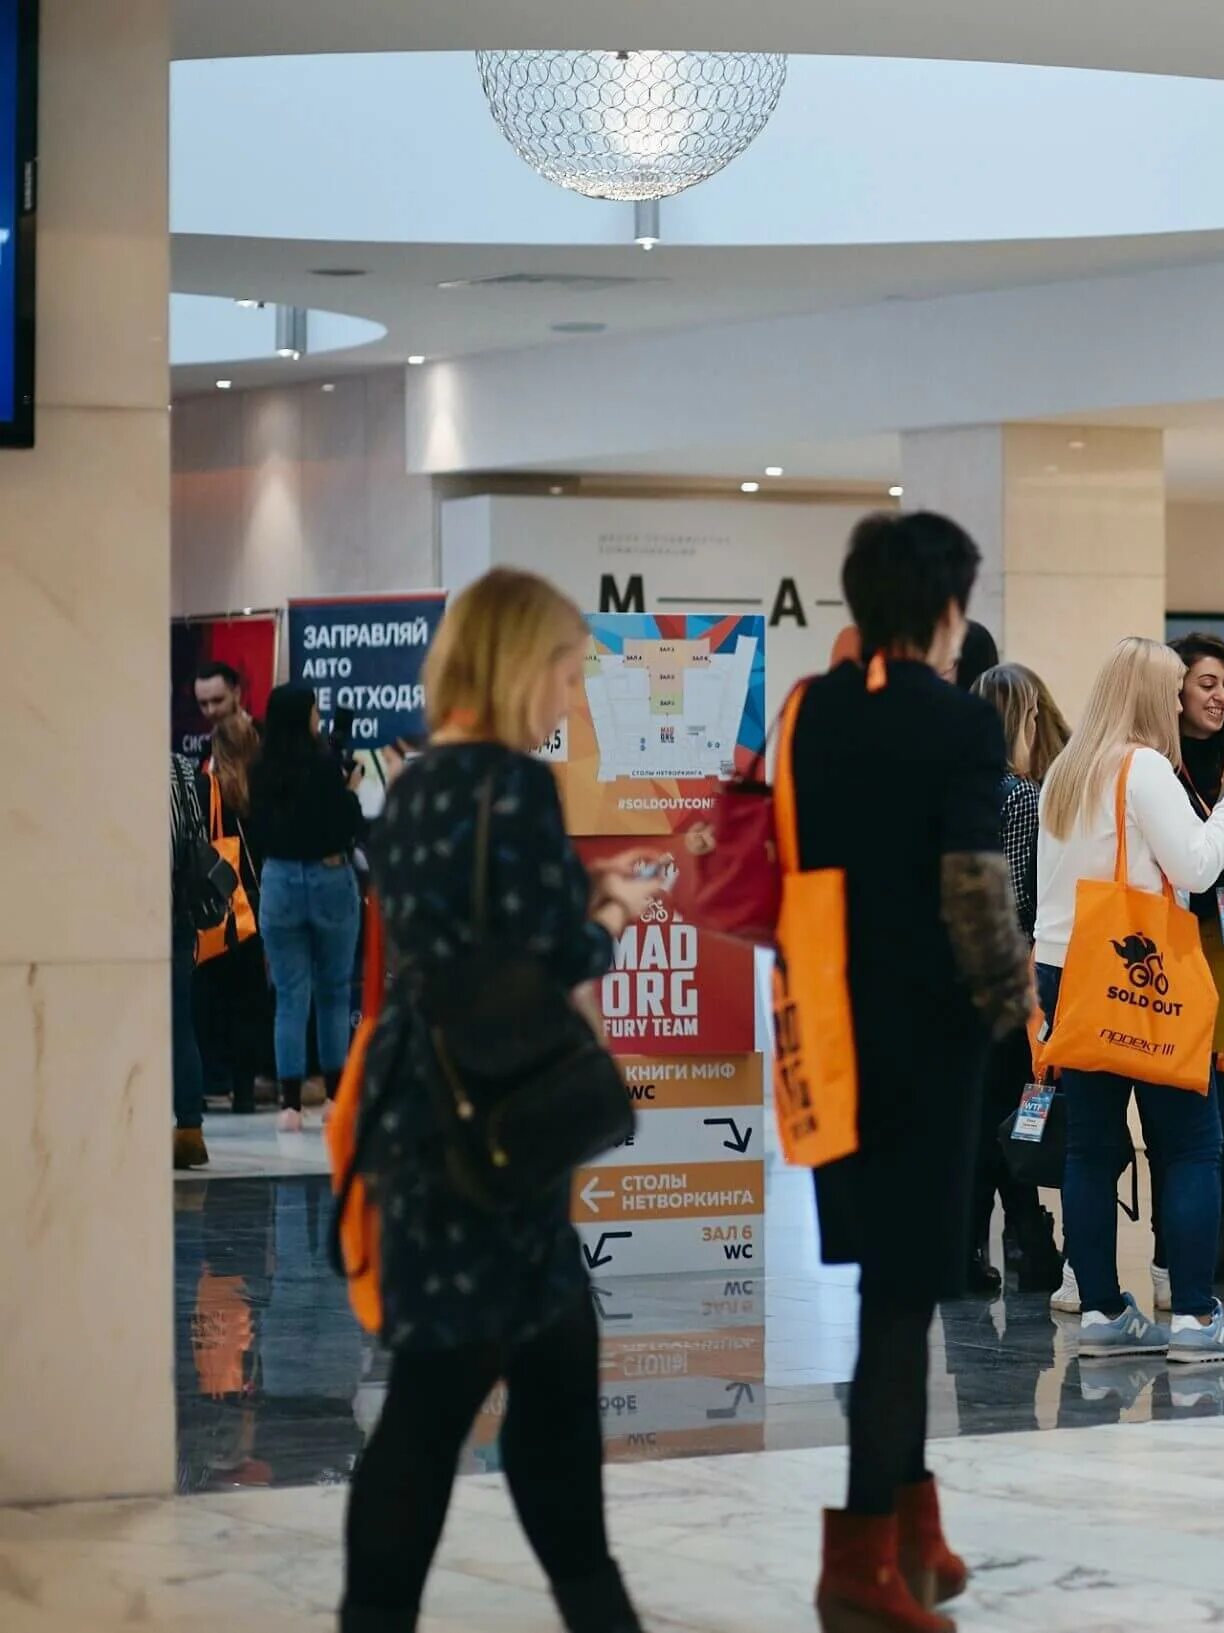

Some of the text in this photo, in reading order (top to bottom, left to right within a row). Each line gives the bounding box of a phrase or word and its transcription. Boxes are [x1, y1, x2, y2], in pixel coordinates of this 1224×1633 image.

[303, 616, 428, 649] ЗАПРАВЛЯЙ
[302, 657, 352, 679] АВТО
[314, 684, 426, 712] Е ОТХОДЯ
[610, 924, 698, 970] MAD
[602, 971, 698, 1017] ORG
[1107, 986, 1183, 1016] SOLD OUT
[603, 1018, 698, 1038] FURY TEAM
[625, 1062, 736, 1081] КНИГИ МИФ
[626, 1085, 656, 1100] WC
[621, 1174, 687, 1191] СТОЛЫ
[621, 1190, 754, 1210] НЕТВОРКИНГА
[702, 1225, 752, 1242] ЗАЛ 6
[724, 1244, 753, 1259] WC
